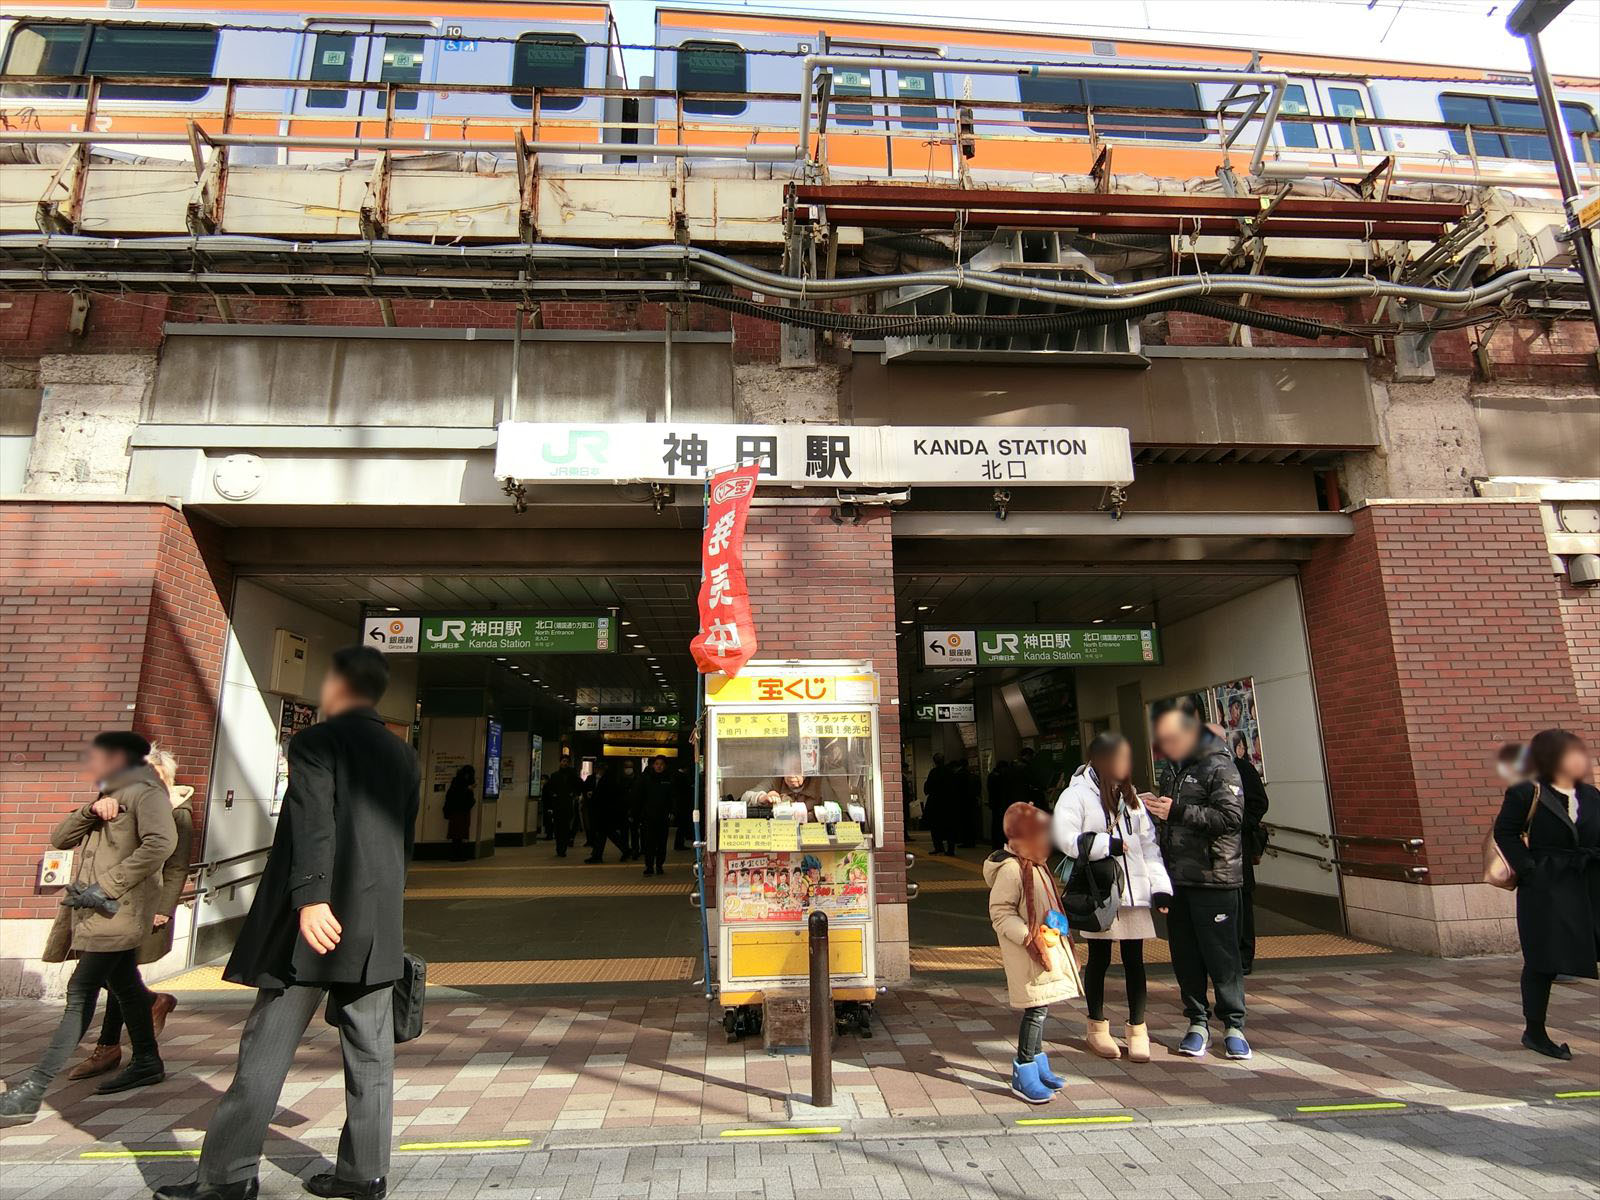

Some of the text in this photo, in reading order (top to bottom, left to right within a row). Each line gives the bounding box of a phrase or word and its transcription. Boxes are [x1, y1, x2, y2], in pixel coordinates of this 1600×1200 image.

[448, 27, 461, 36] 10
[800, 44, 809, 53] 9
[542, 430, 608, 464] JR
[913, 439, 1087, 456] KANDA STATION
[662, 432, 852, 479] 神田駅
[981, 459, 1027, 480] 北口
[426, 620, 466, 641] JR
[470, 620, 522, 636] 神田駅
[468, 639, 498, 648] Kanda
[500, 638, 531, 648] Station
[982, 633, 1020, 654] JR
[1023, 633, 1071, 649] 神田駅
[988, 654, 1016, 662] JR東日本
[1023, 651, 1051, 660] Kanda
[1052, 650, 1082, 660] Station
[757, 678, 827, 700] 宝くじ
[916, 706, 934, 717] JR
[653, 716, 668, 725] JR
[718, 716, 787, 725] 初夢宝くじ
[803, 714, 868, 724] スクラッチくじ
[763, 727, 787, 735] 発売中
